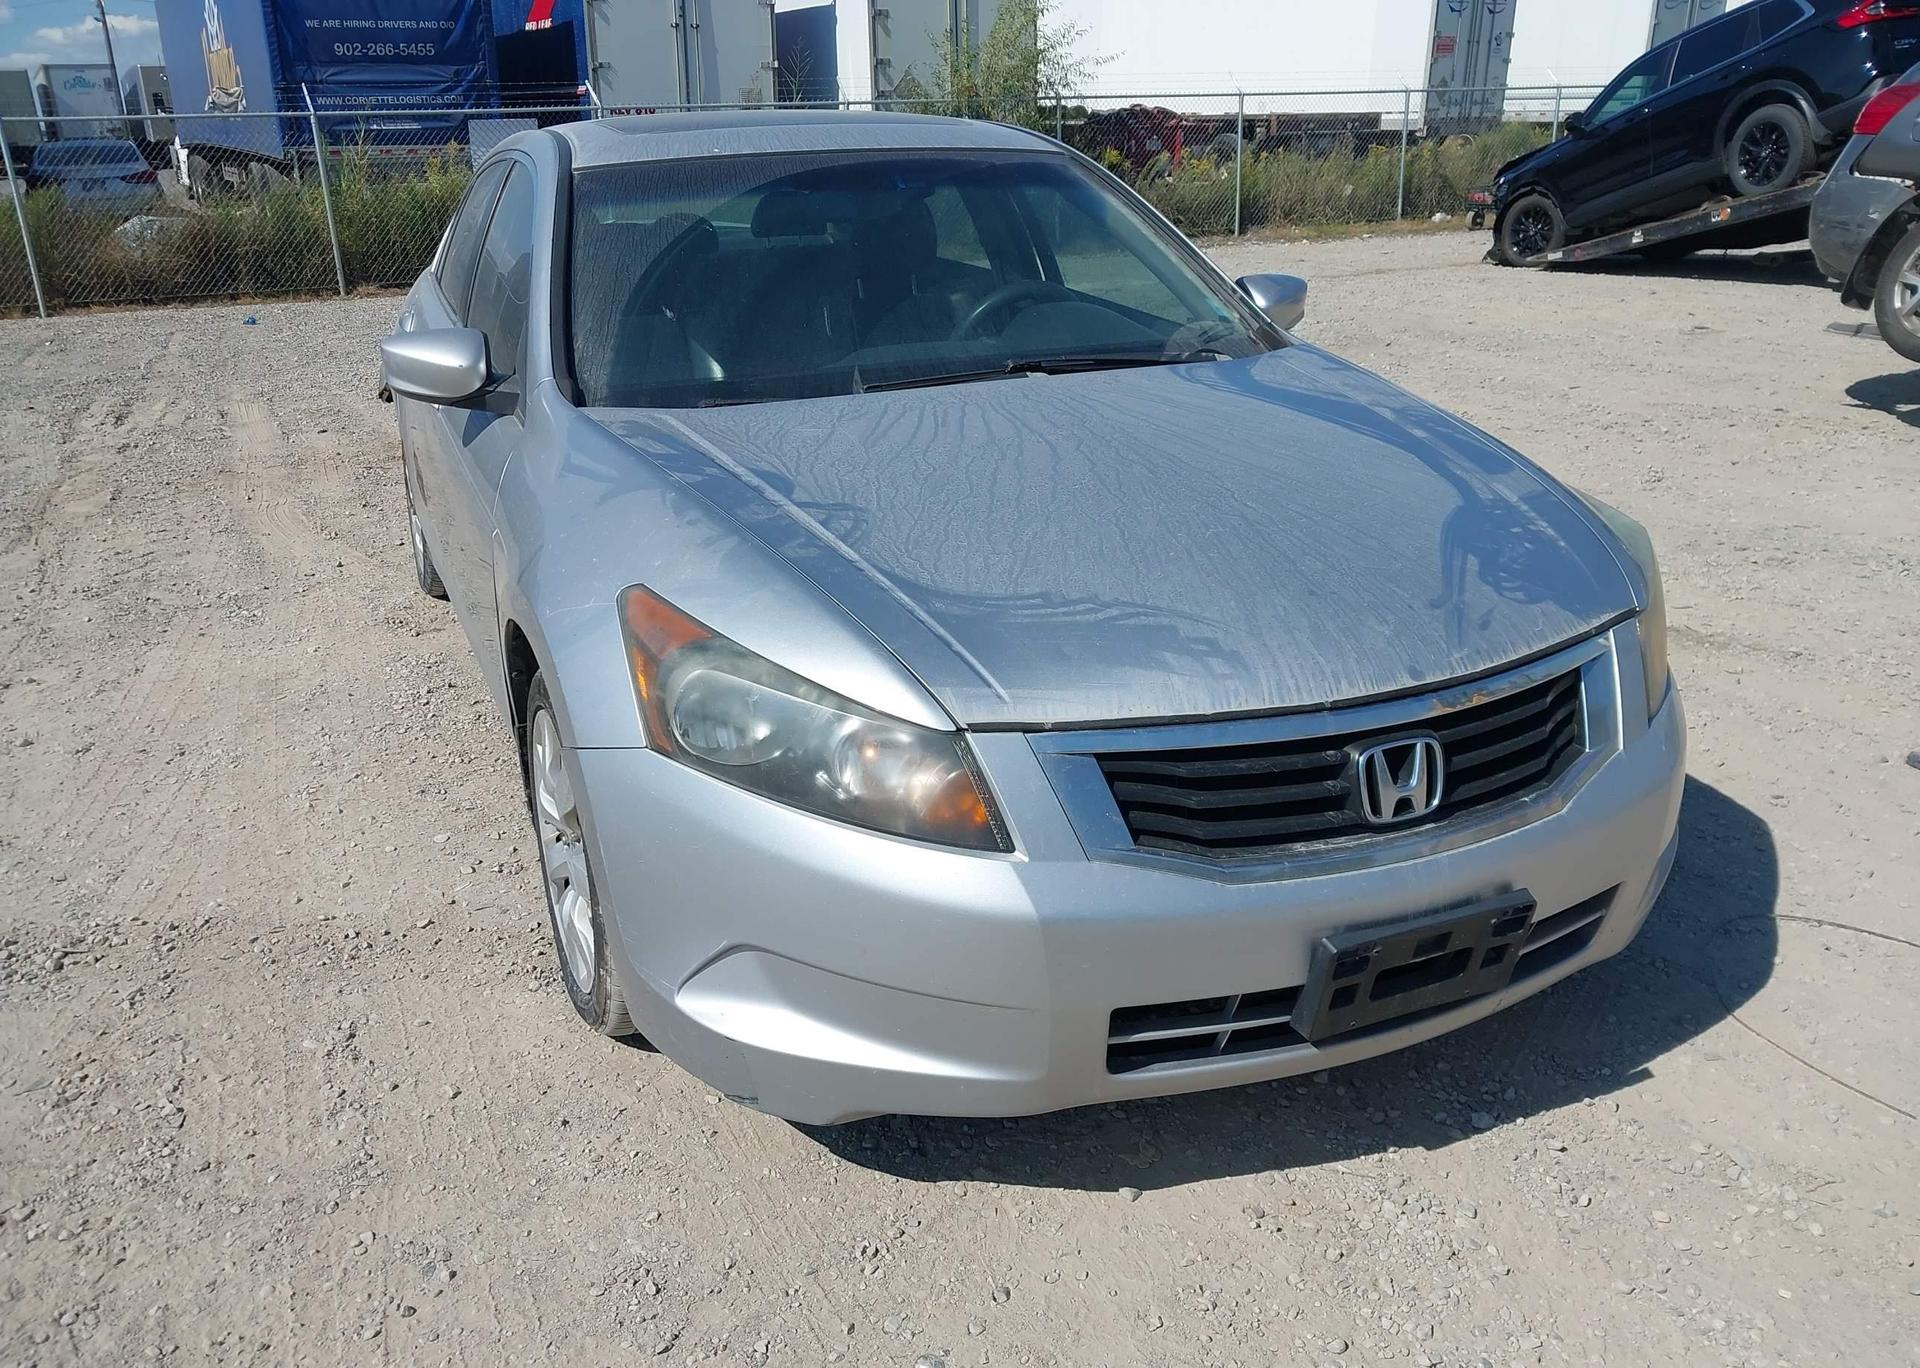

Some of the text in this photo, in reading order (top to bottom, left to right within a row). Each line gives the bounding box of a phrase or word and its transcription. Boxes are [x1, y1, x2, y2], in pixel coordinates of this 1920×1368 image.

[304, 19, 320, 28] WE
[322, 20, 342, 28] ARE
[343, 20, 376, 28] HIRING
[377, 20, 417, 29] DRIVERS
[418, 21, 438, 29] AND
[334, 42, 435, 56] 902-266-5455
[316, 95, 464, 105] WWW.CORVETTELOGISTICS.COM
